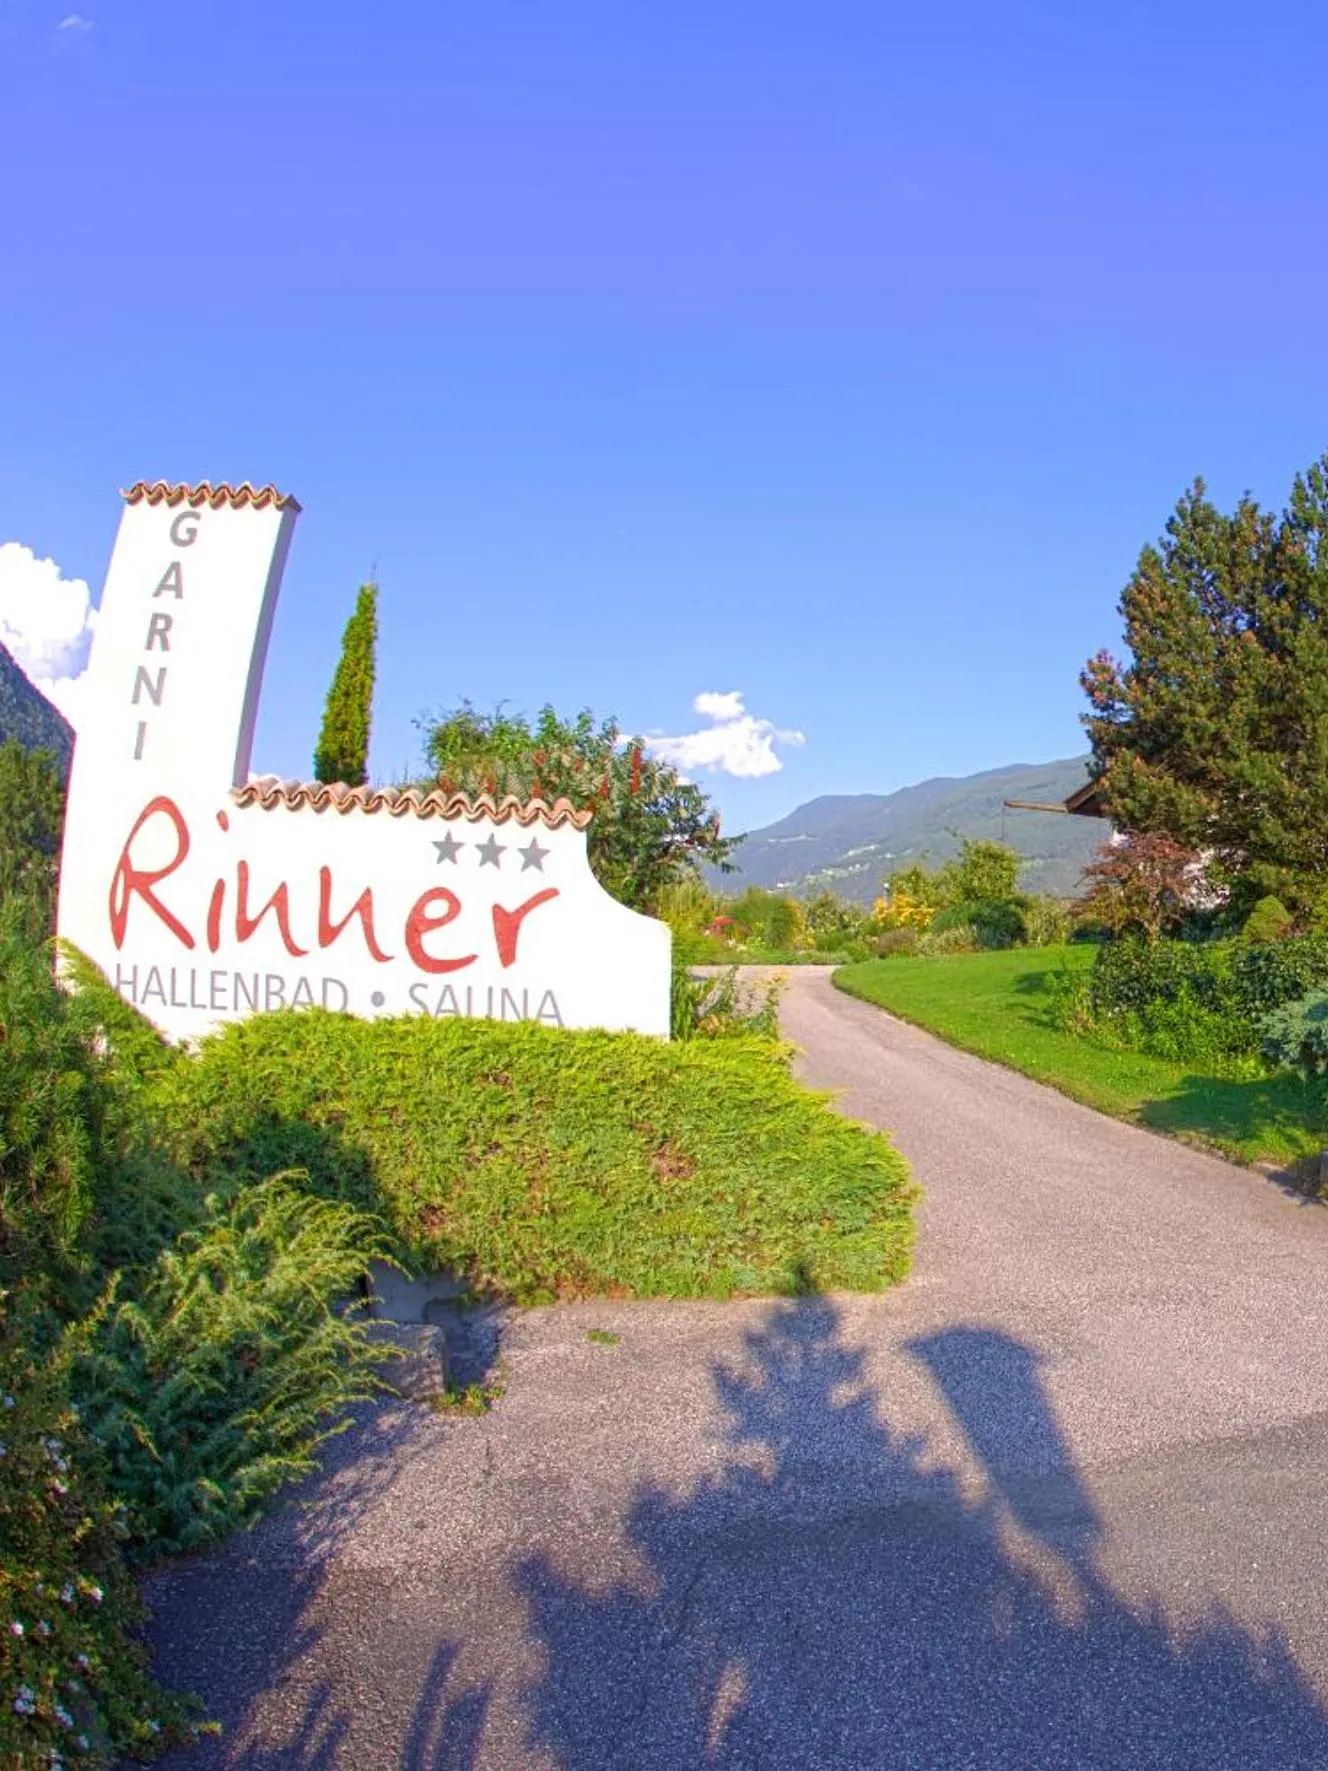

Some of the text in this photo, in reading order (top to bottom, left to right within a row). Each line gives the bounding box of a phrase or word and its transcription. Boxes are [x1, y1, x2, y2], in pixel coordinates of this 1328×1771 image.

[131, 509, 201, 761] GARNI
[109, 796, 560, 973] Rinner
[116, 963, 564, 1027] HALLENBAD SAUNA
